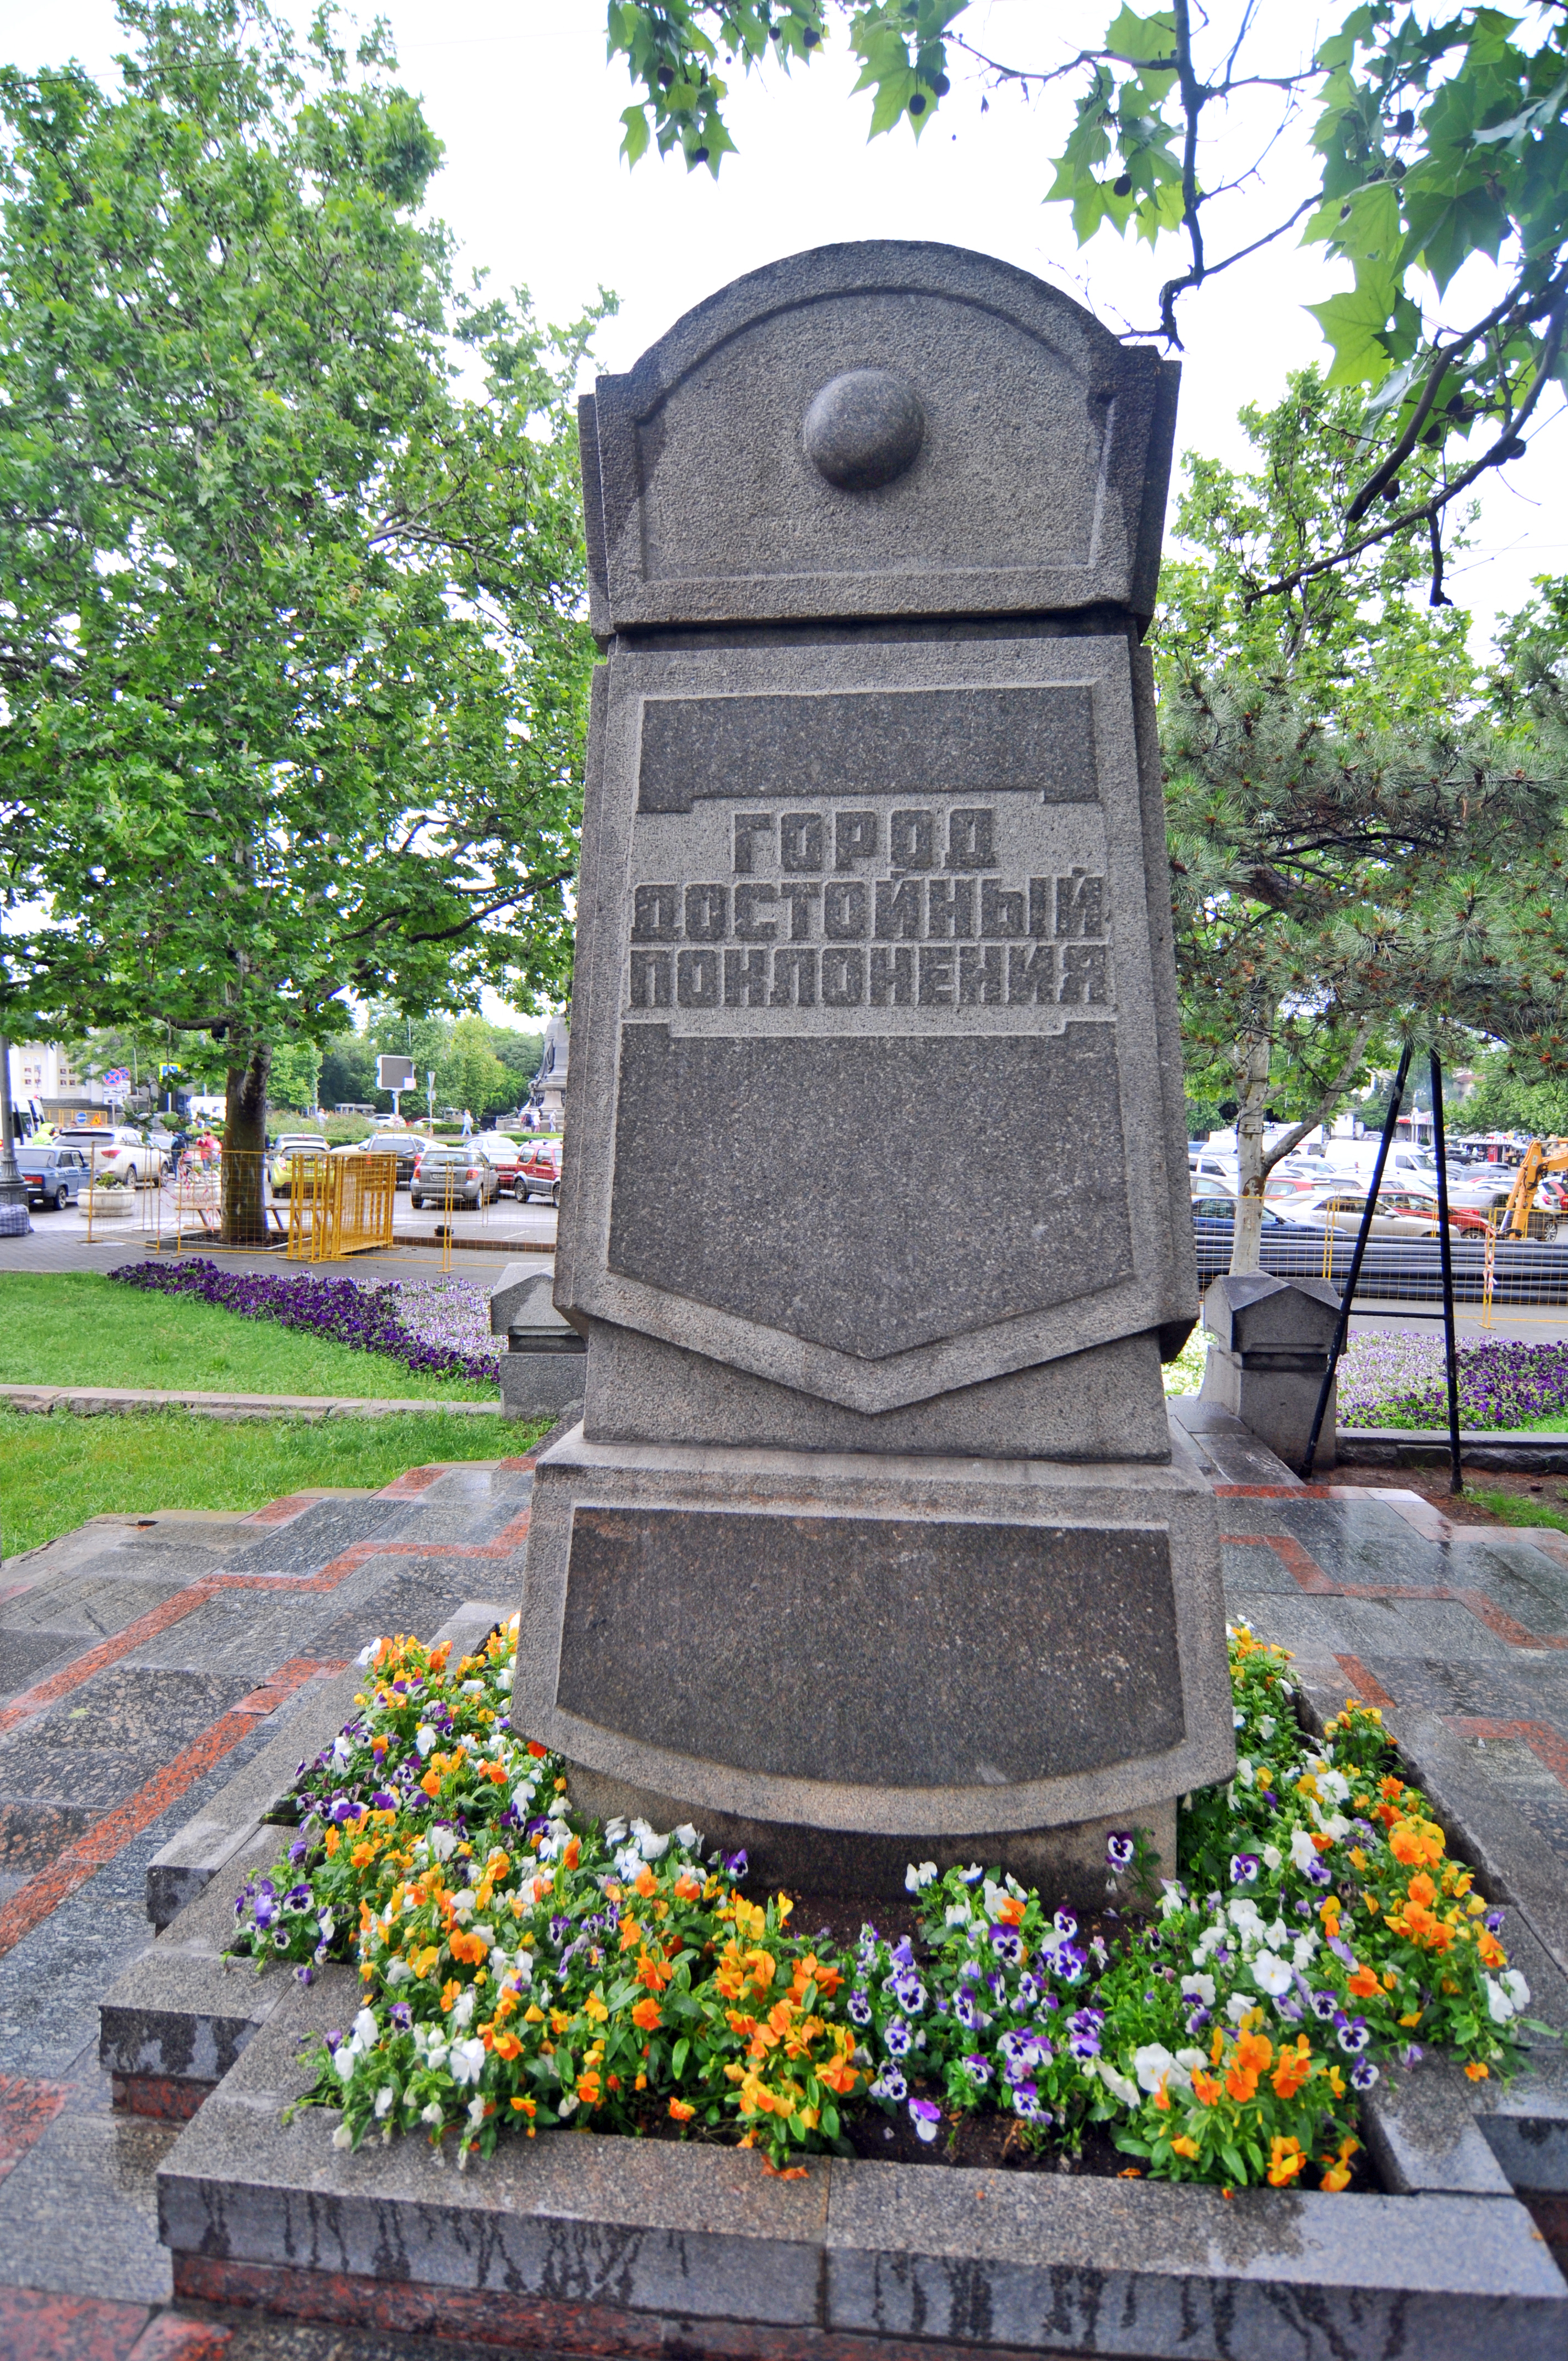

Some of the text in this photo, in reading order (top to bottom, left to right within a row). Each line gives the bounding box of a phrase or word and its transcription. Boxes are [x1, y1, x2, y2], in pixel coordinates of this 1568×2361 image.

[732, 807, 997, 873] ГОРОД
[630, 866, 1102, 942] ДОСТОЙНЫЙ
[629, 943, 1103, 1008] ПОКЛОНЕНИЯ
